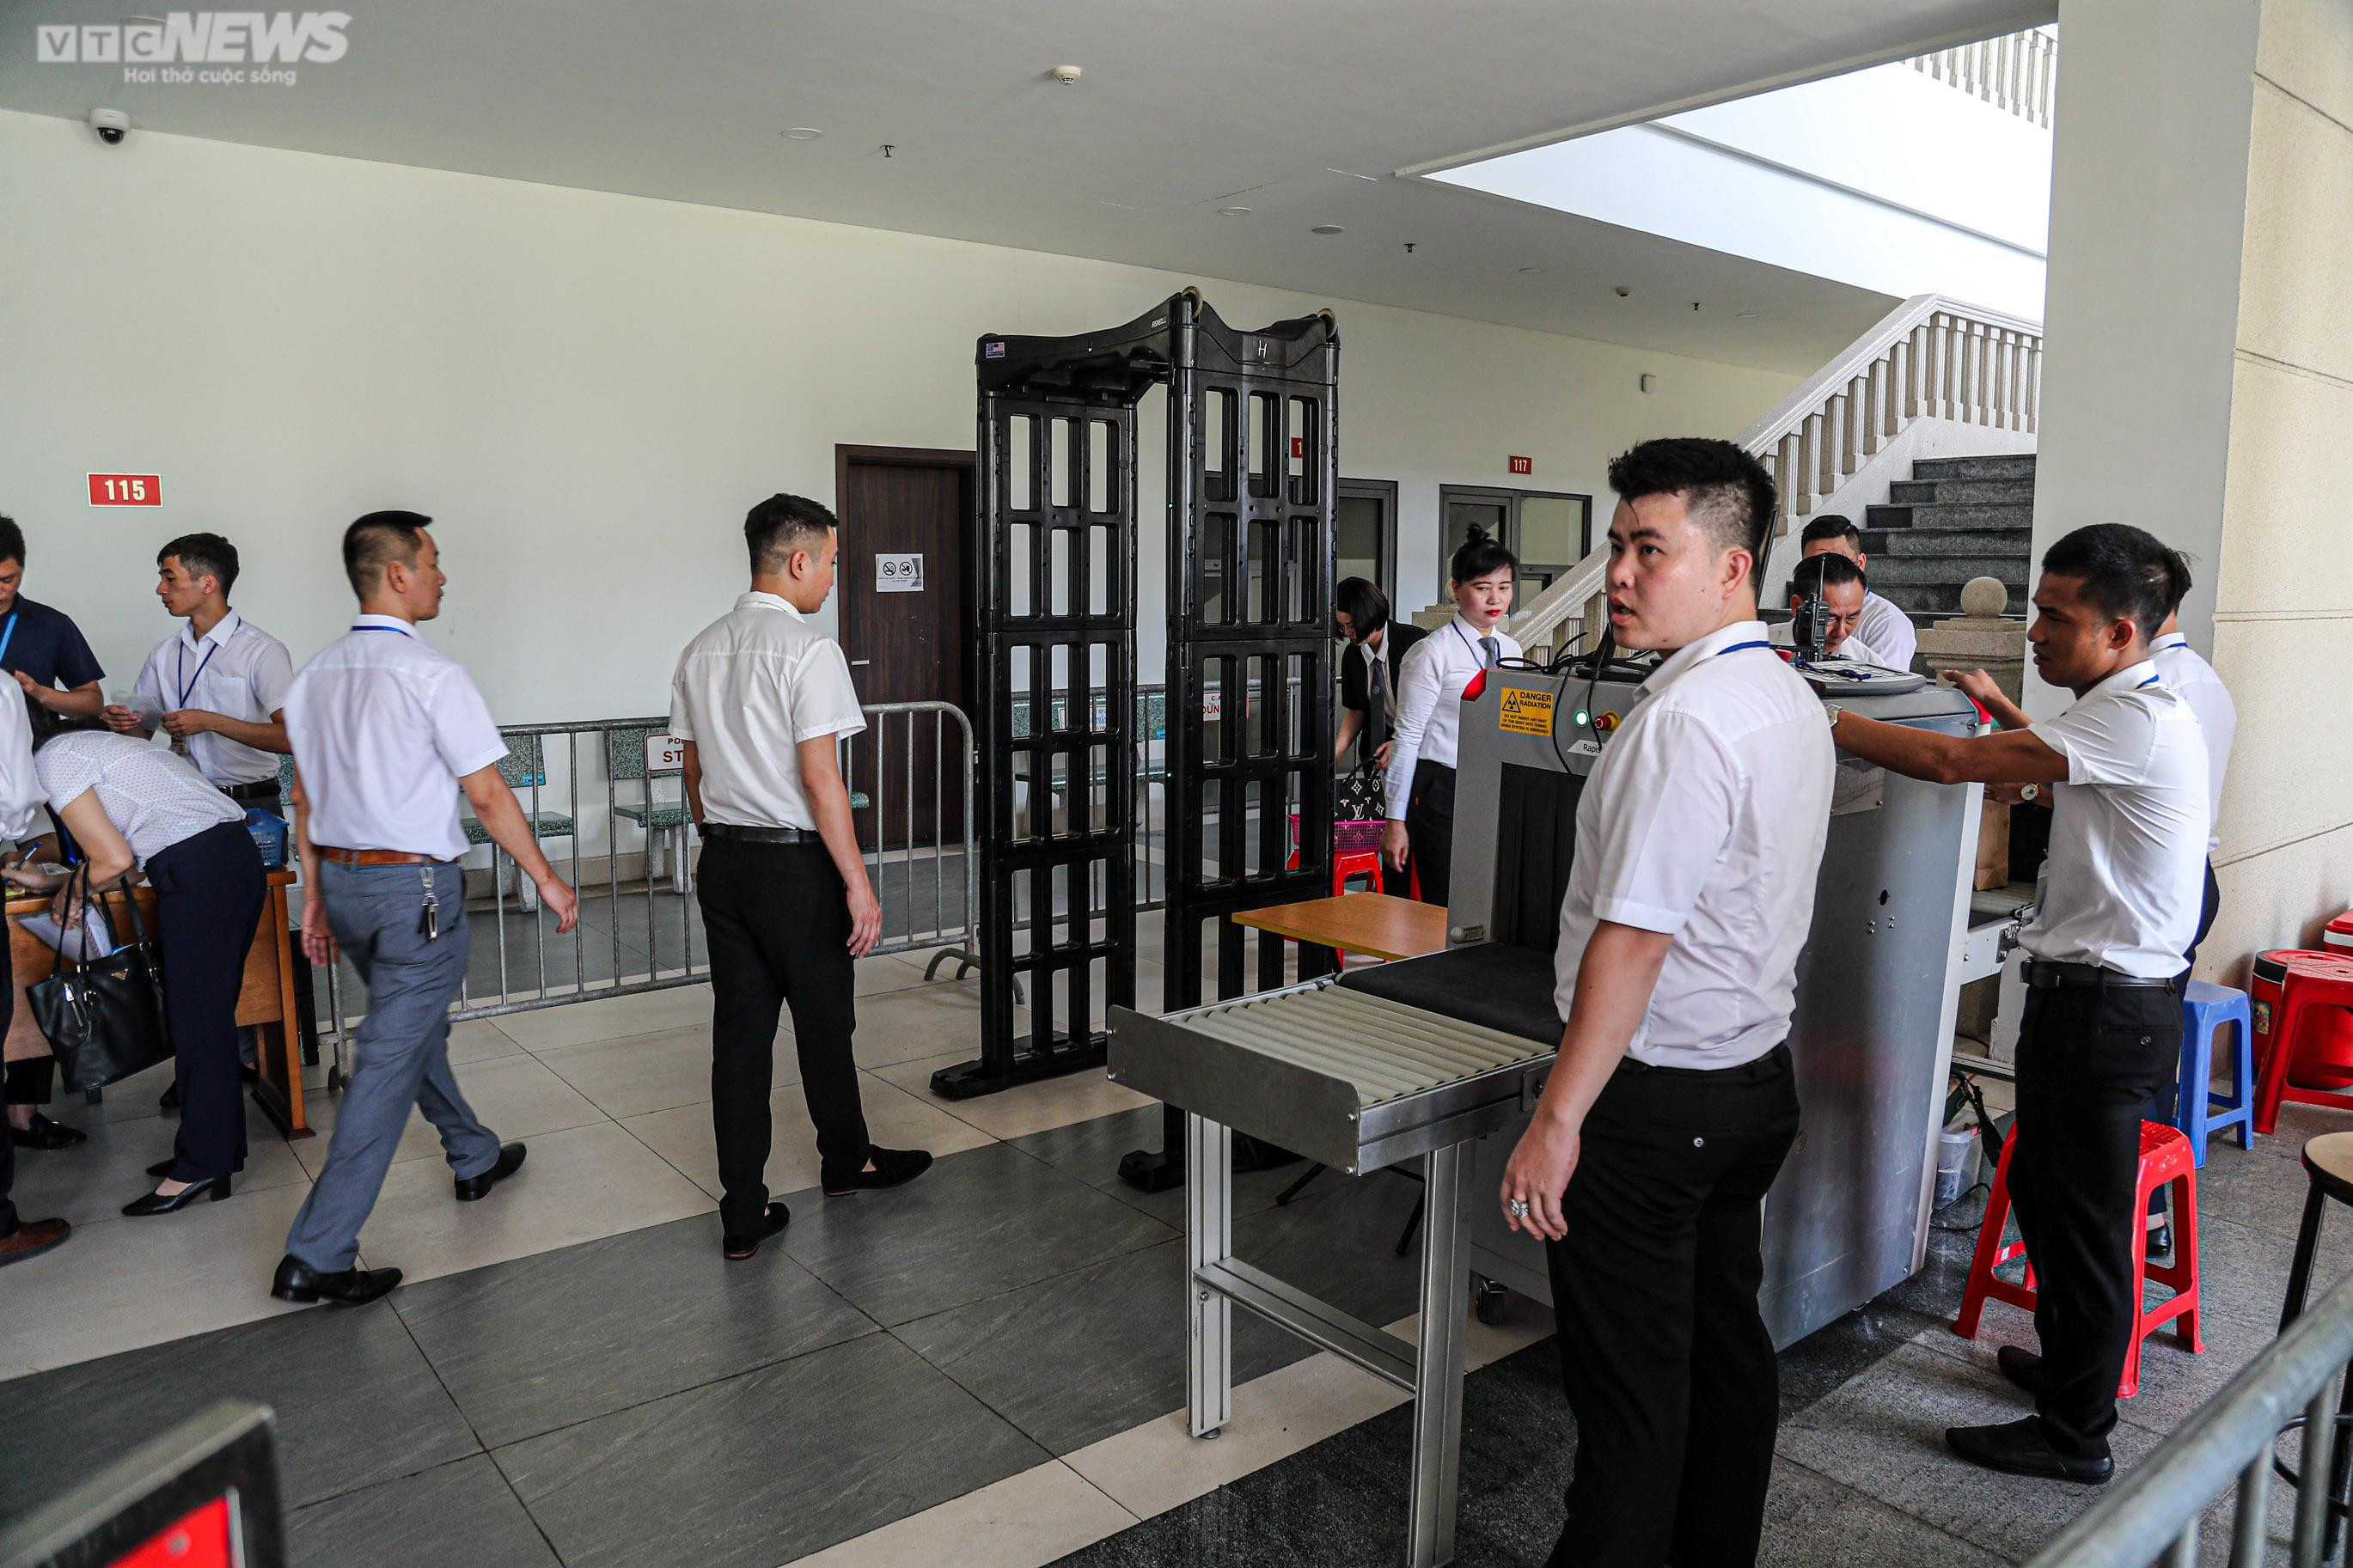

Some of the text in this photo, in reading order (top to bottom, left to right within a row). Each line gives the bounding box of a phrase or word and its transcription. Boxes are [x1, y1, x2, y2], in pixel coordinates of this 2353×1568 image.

[1514, 459, 1527, 472] 117
[104, 479, 145, 501] 115
[1520, 692, 1551, 702] DANGER
[1519, 700, 1551, 710] RADIATION
[663, 750, 684, 763] ST
